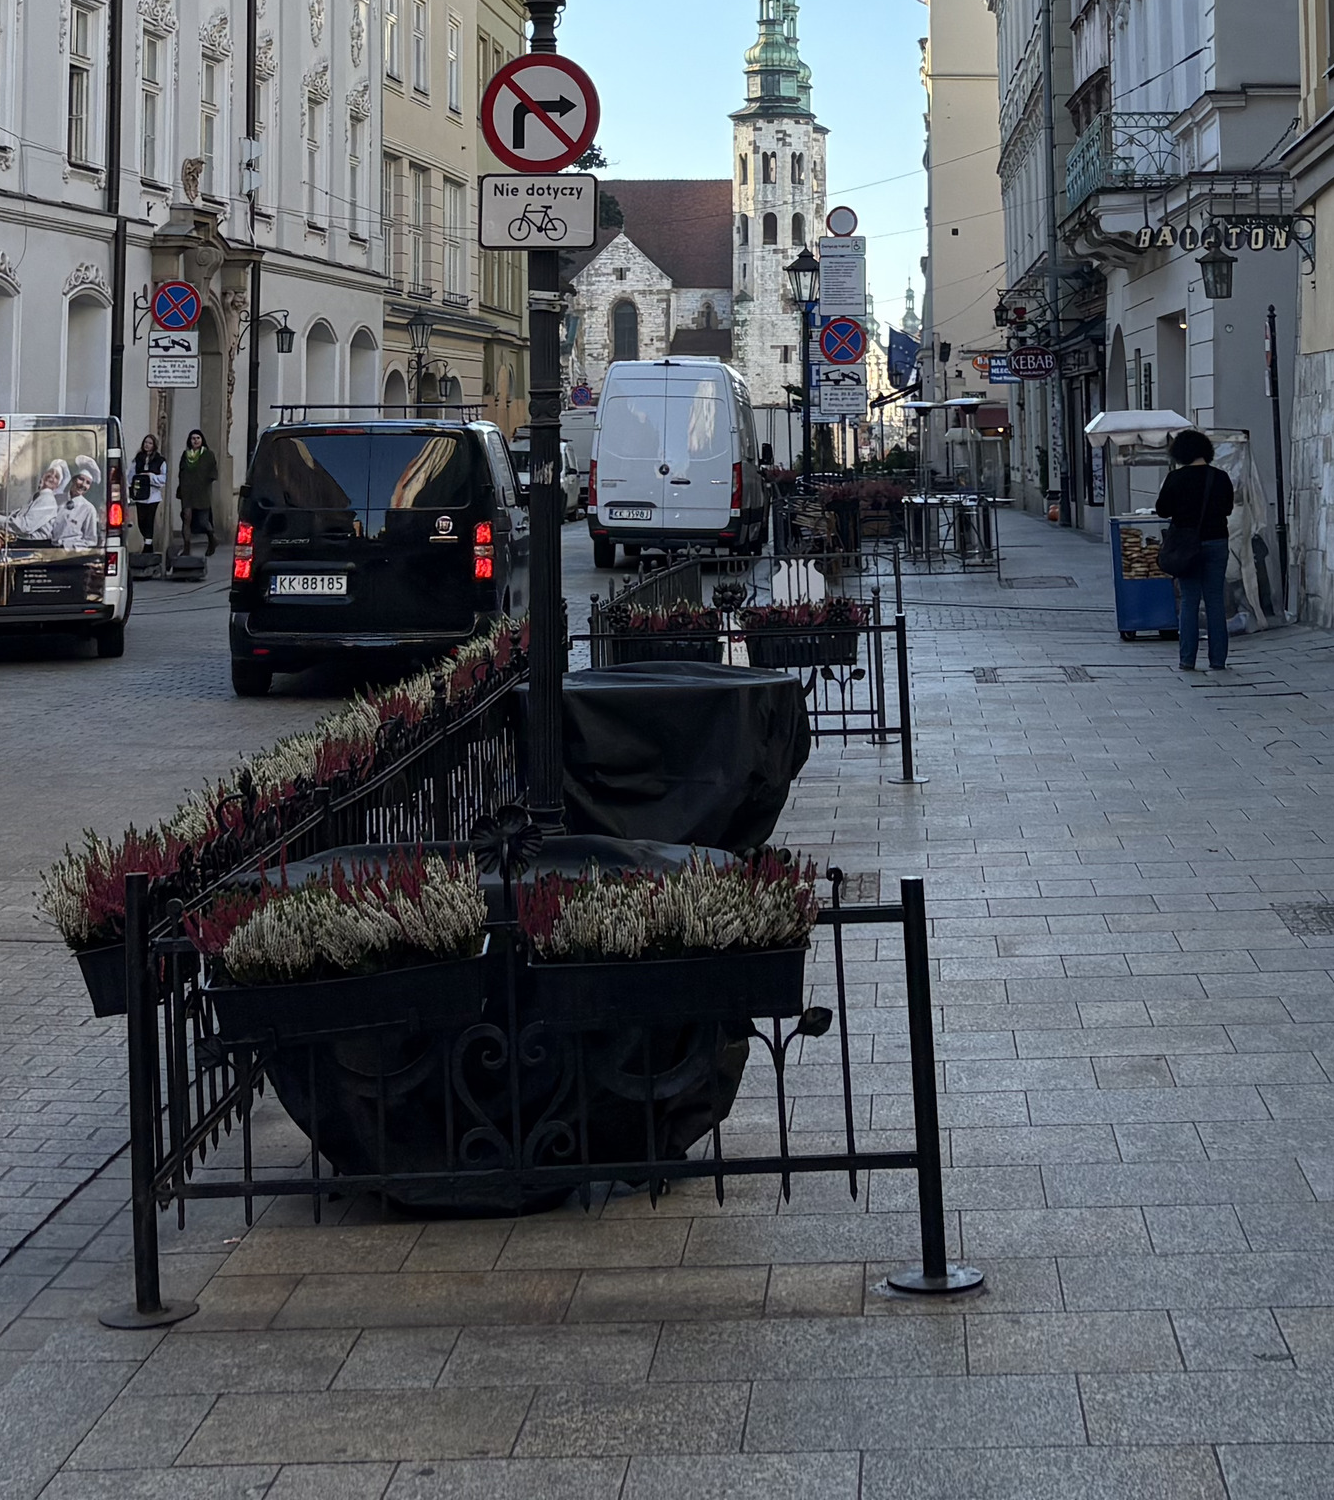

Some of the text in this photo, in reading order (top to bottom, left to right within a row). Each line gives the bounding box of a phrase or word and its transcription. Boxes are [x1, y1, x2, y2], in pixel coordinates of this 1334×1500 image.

[494, 183, 583, 200] Nie dotyczy
[1011, 355, 1054, 369] KEBAB
[279, 577, 344, 591] KK 88185
